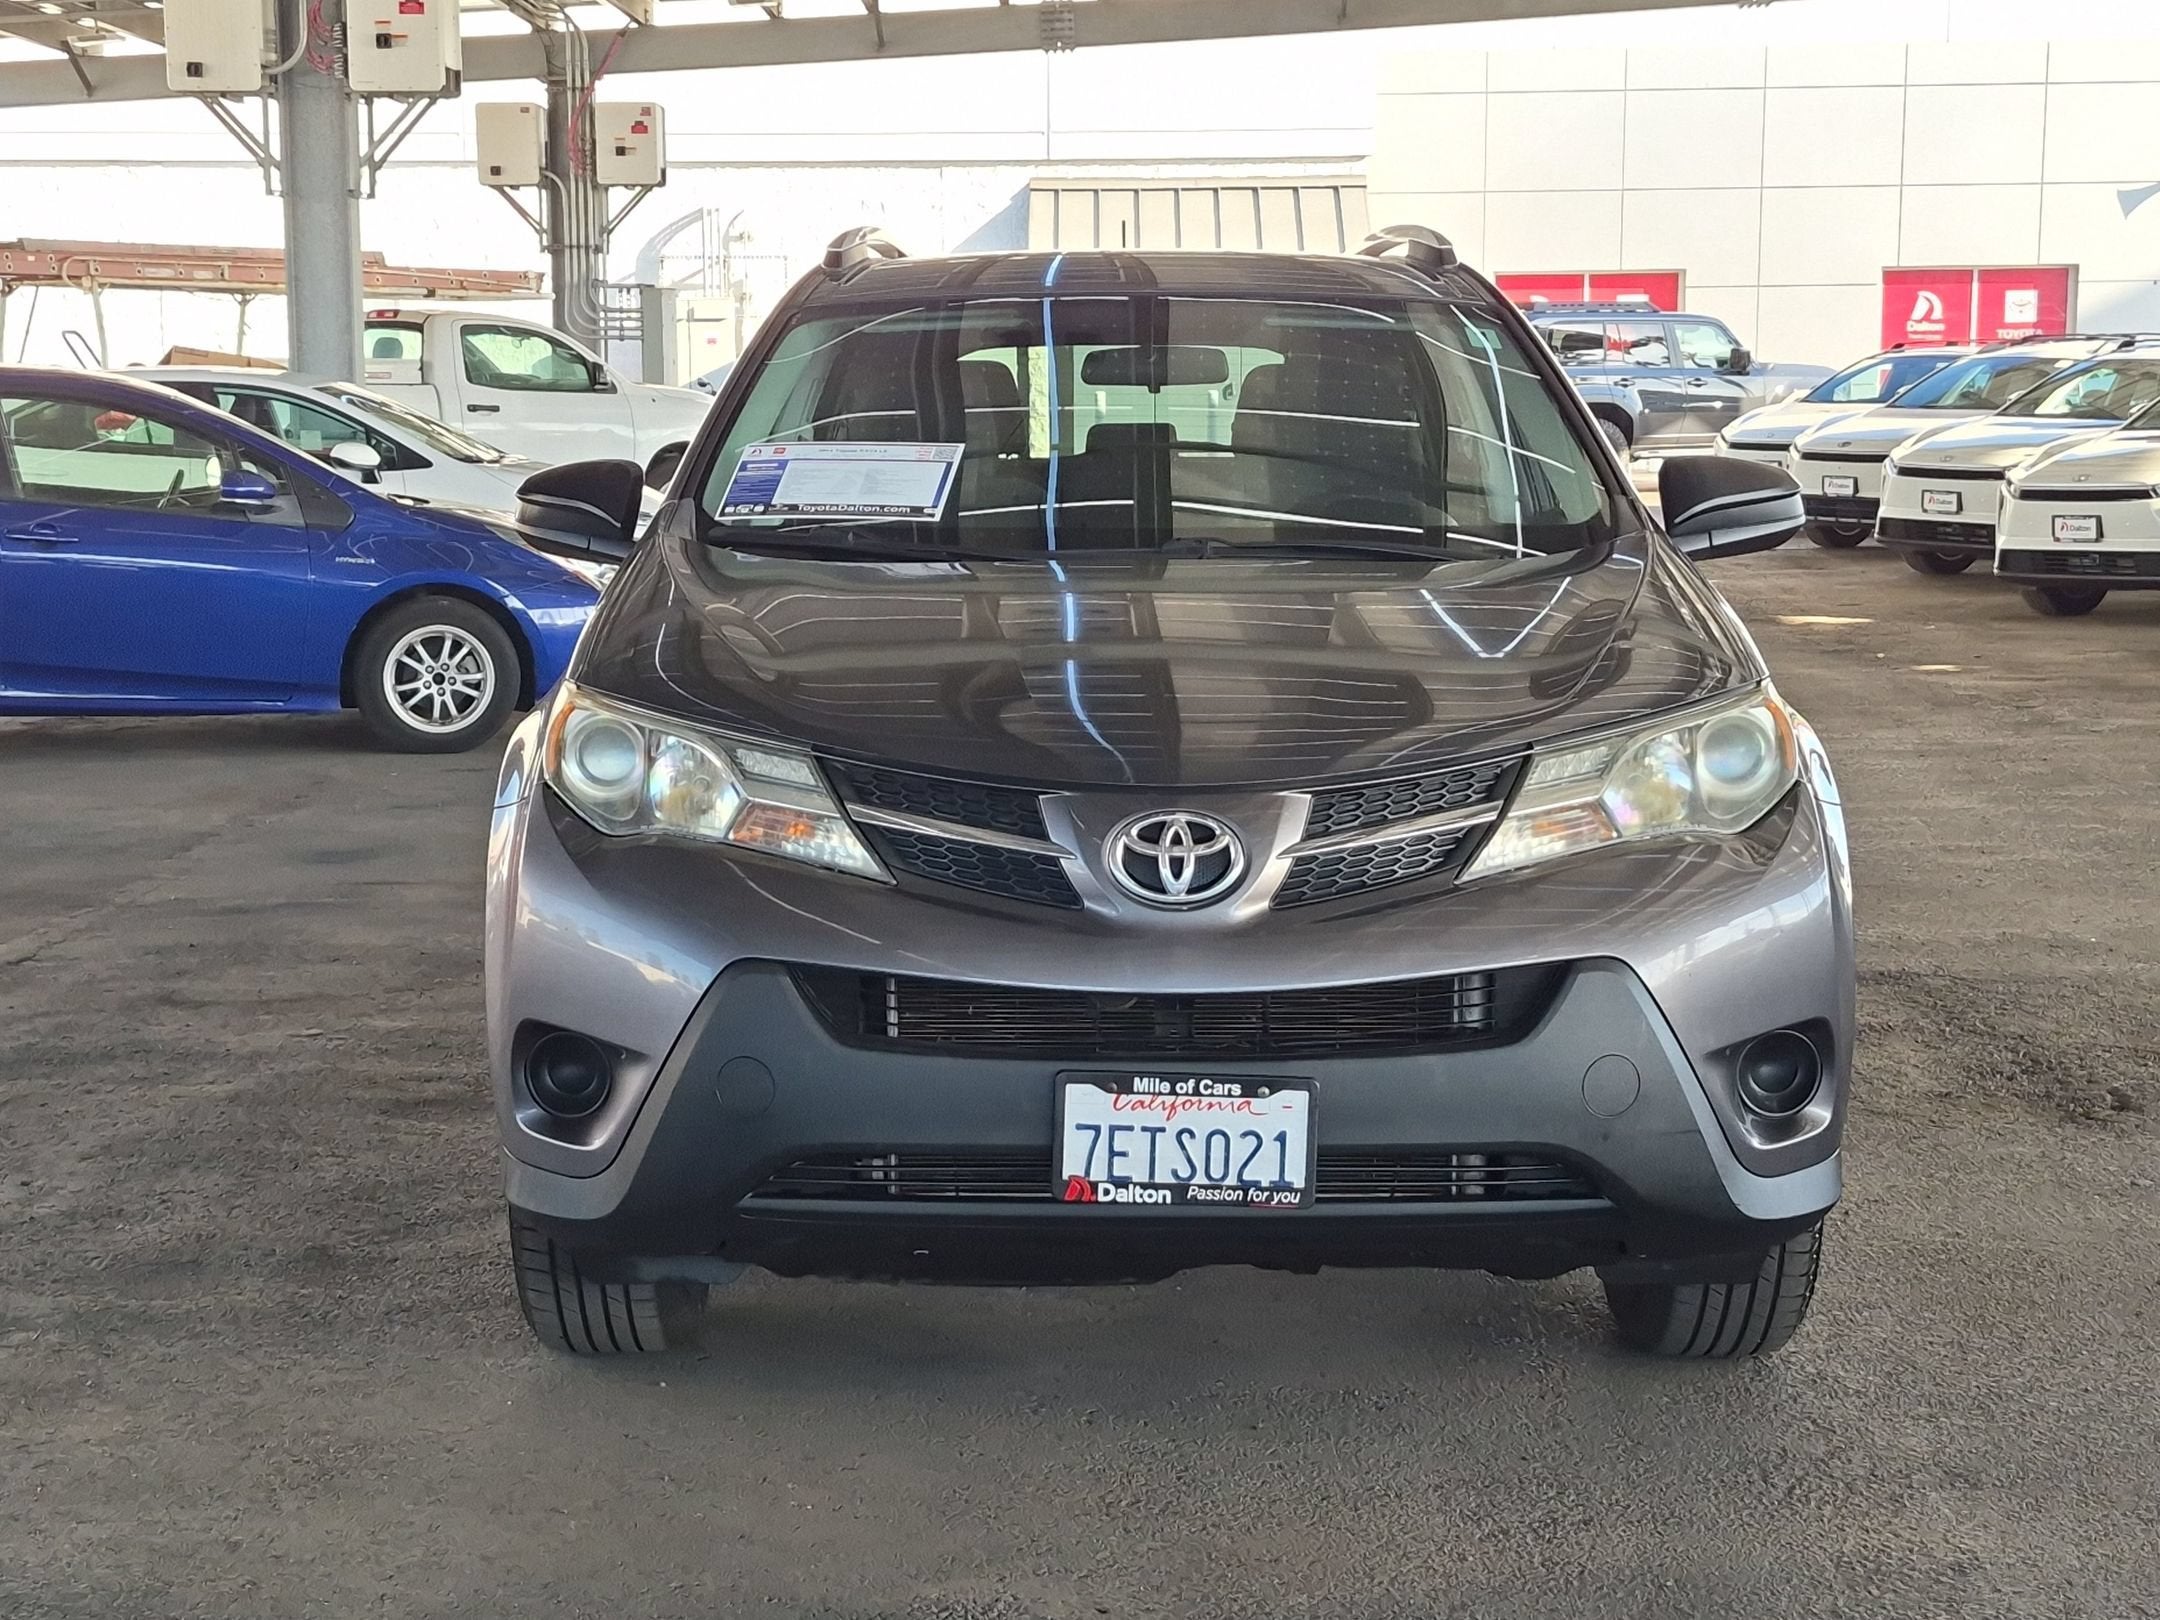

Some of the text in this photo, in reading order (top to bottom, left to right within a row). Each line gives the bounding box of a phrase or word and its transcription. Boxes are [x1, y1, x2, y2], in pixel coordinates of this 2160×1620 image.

[797, 504, 911, 514] ToyotaDalton.com
[1133, 1077, 1242, 1096] Mile of Cars
[1112, 1093, 1268, 1122] California
[1075, 1123, 1294, 1188] 7ETS021
[1097, 1183, 1172, 1204] Dalton
[1187, 1186, 1301, 1205] Passion for you
